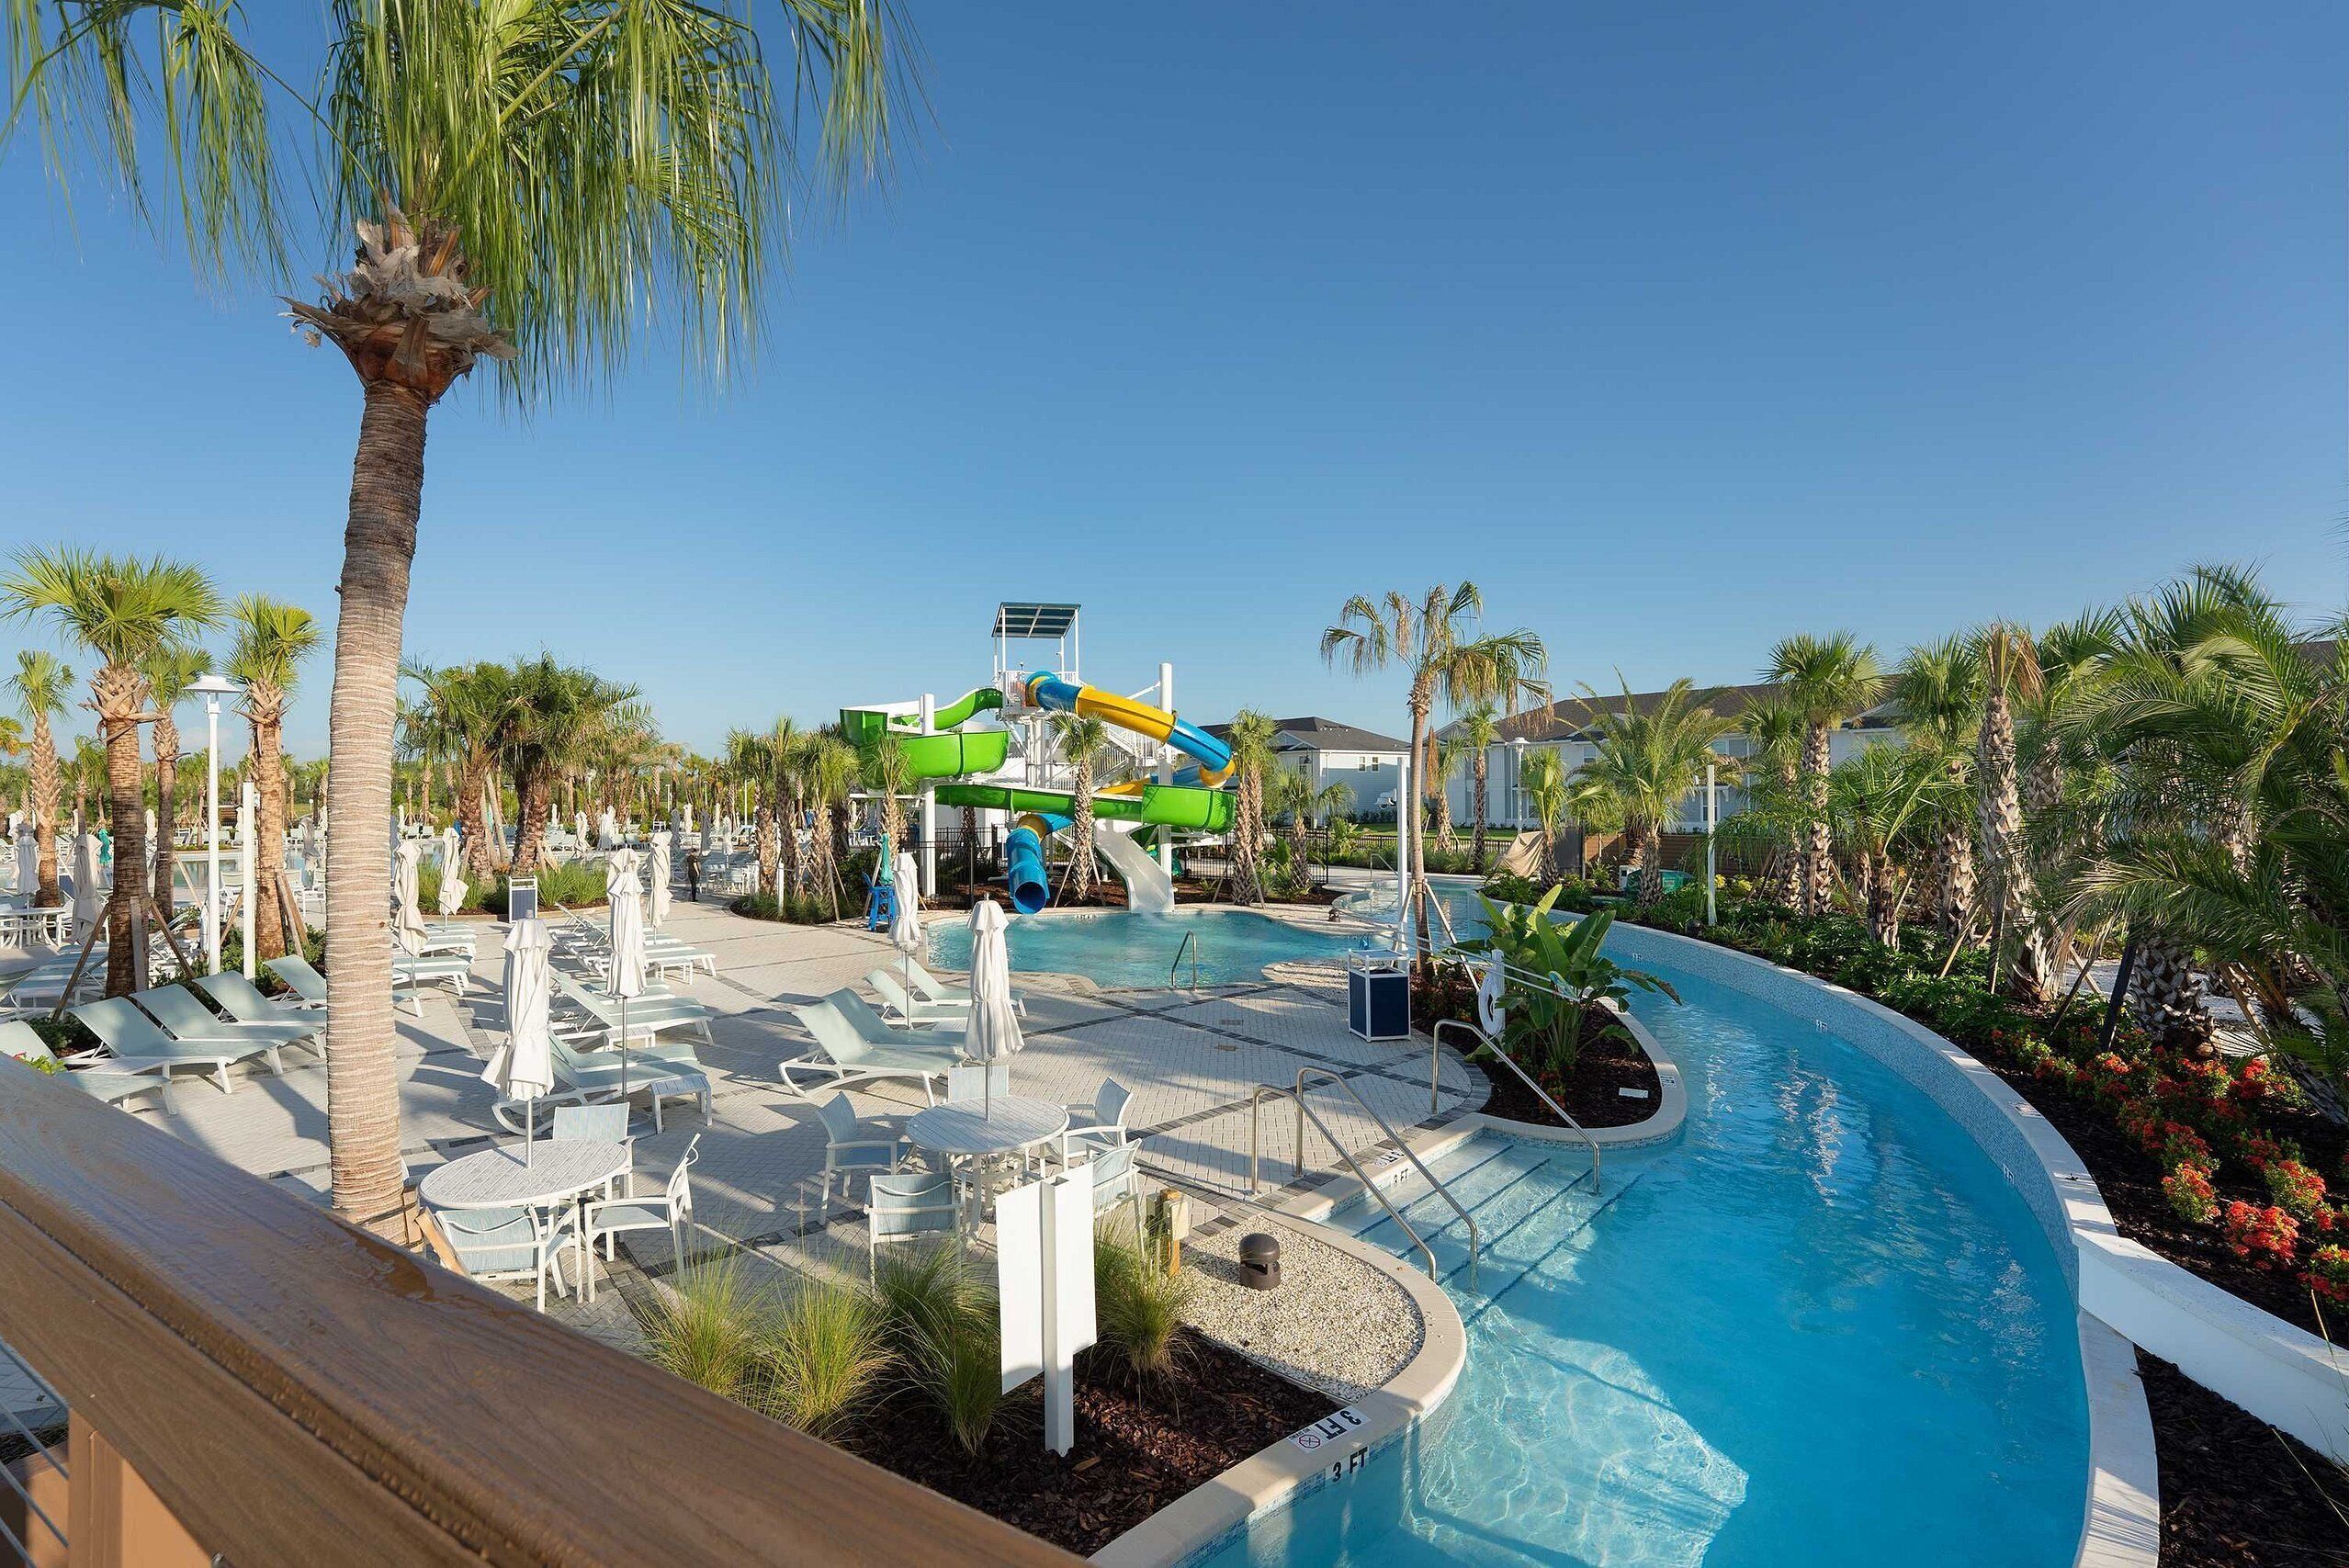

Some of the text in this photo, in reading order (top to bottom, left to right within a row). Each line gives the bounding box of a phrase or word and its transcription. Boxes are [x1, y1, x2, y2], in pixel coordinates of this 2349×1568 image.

[1400, 1168, 1408, 1182] FT
[1339, 1410, 1361, 1425] 3
[1315, 1417, 1347, 1439] FT
[1332, 1447, 1368, 1483] 3 FT
